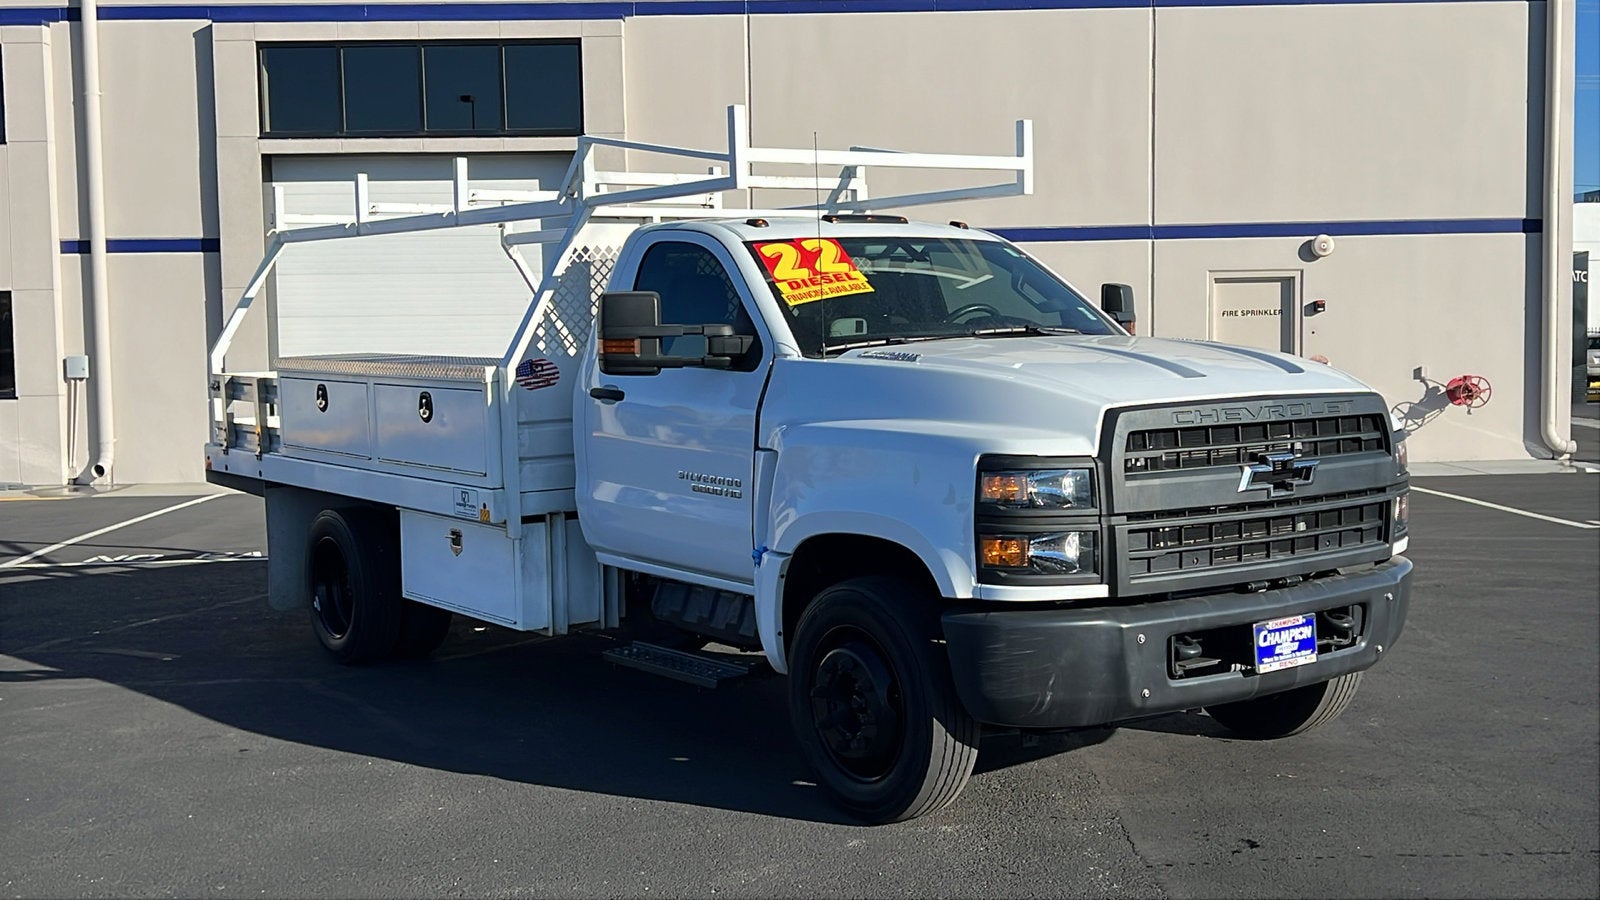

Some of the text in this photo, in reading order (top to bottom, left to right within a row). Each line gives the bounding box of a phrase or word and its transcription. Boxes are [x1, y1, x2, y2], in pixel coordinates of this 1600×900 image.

[760, 239, 851, 280] 22
[787, 272, 859, 290] DIESEL
[785, 282, 870, 303] FINANCING AVAILABLE
[1240, 309, 1283, 317] SPRINKLER
[1171, 400, 1354, 425] CHEVROLET
[677, 470, 742, 488] SILVERADO
[1271, 618, 1299, 628] CHAMPION
[1259, 625, 1312, 647] CHAMPION
[1279, 659, 1299, 667] RENO
